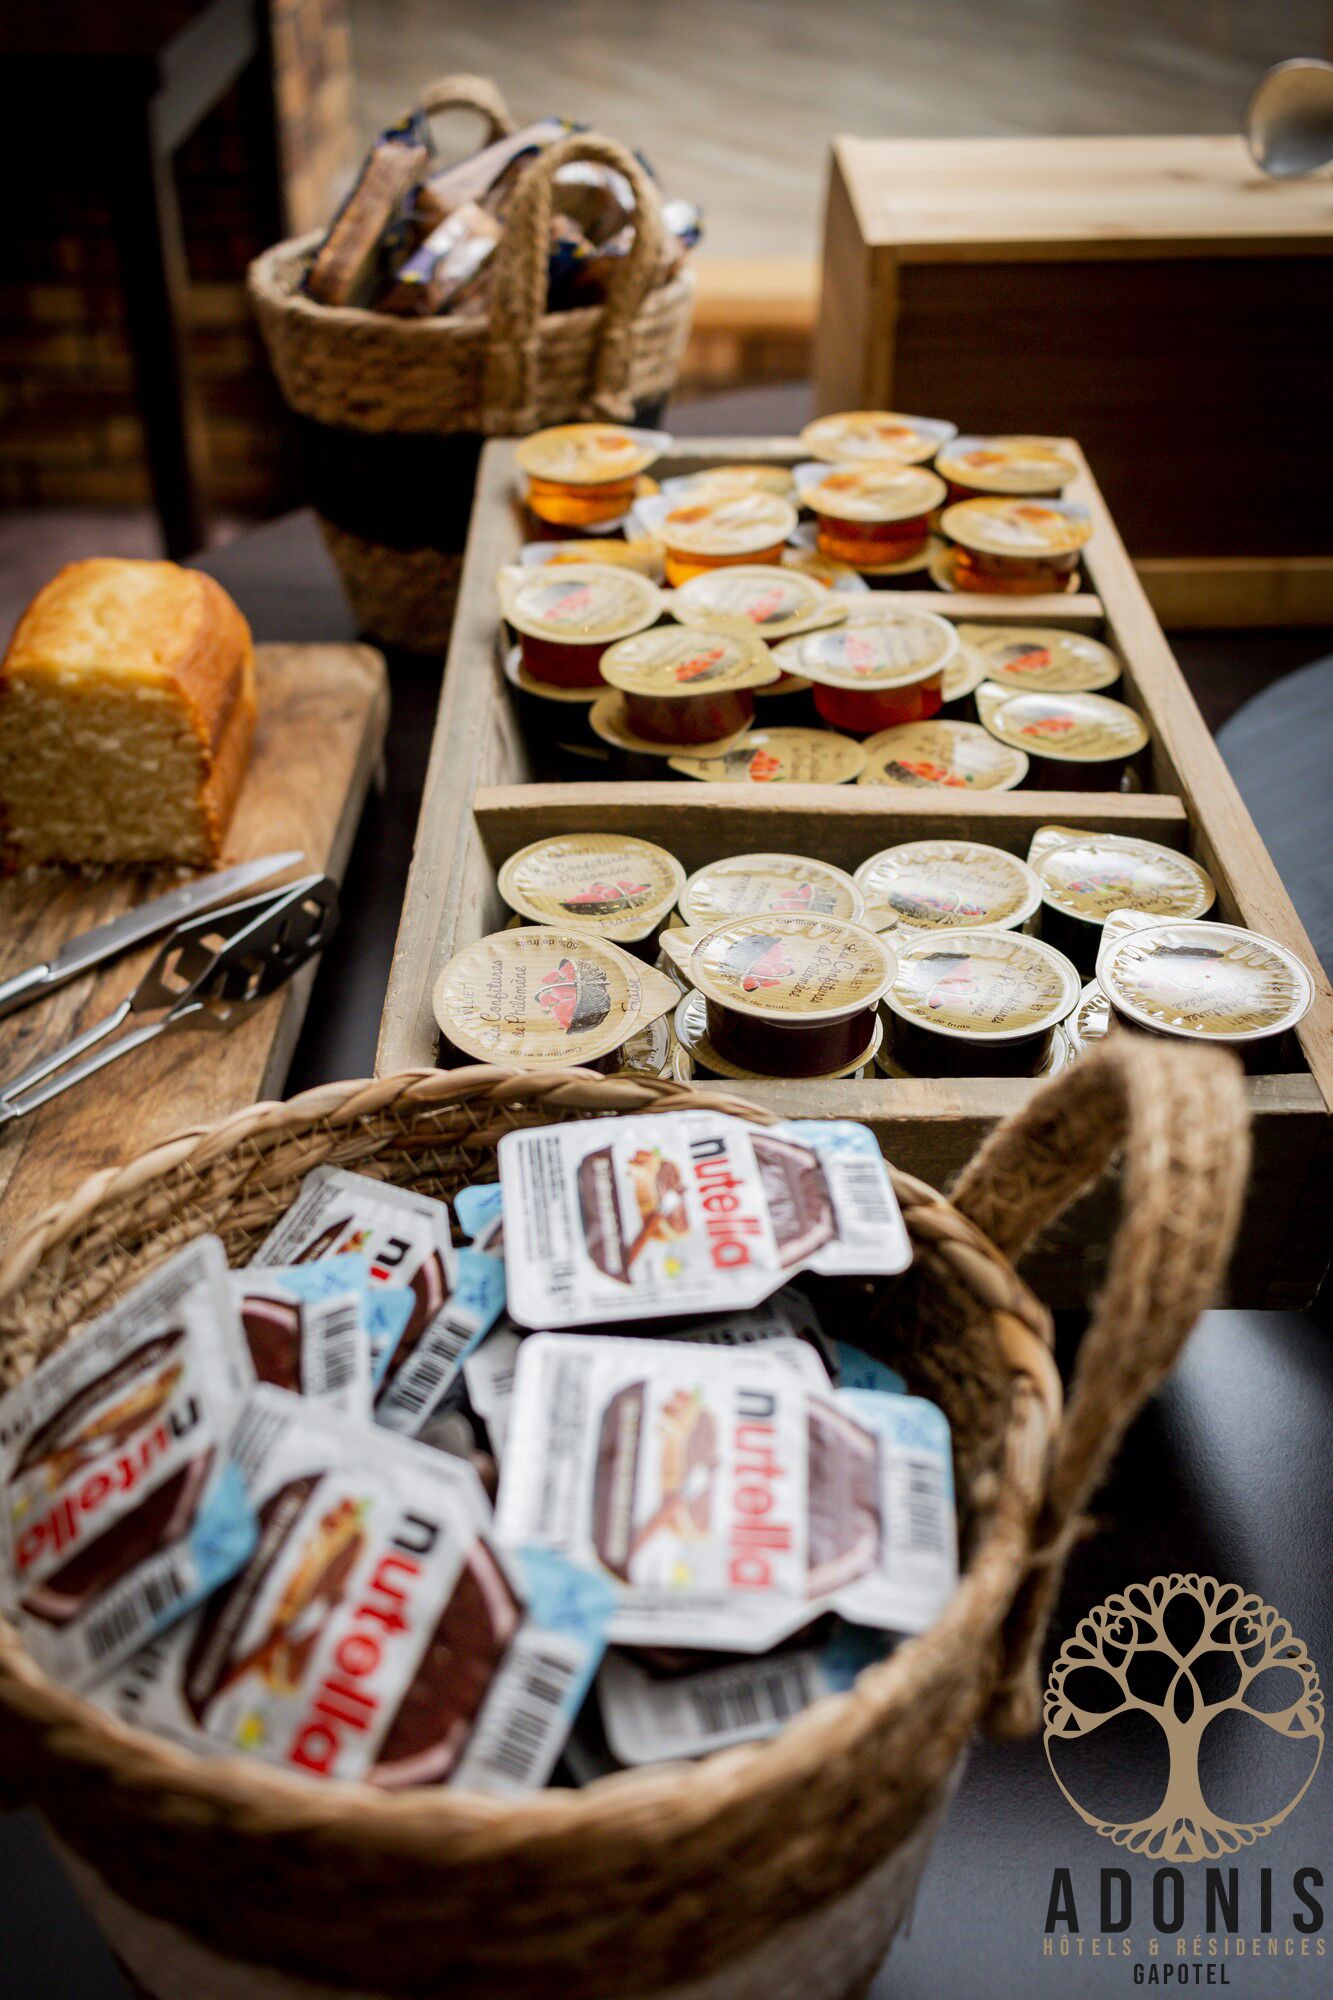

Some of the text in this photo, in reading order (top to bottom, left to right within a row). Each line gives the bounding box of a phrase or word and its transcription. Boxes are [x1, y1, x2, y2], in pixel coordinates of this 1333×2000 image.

[480, 959, 508, 1023] Confitures
[504, 965, 527, 1024] Philomène
[542, 938, 555, 947] de
[689, 1136, 765, 1271] nutella
[14, 1393, 199, 1570] nutella
[727, 1387, 794, 1590] nutella
[289, 1510, 440, 1778] nutella
